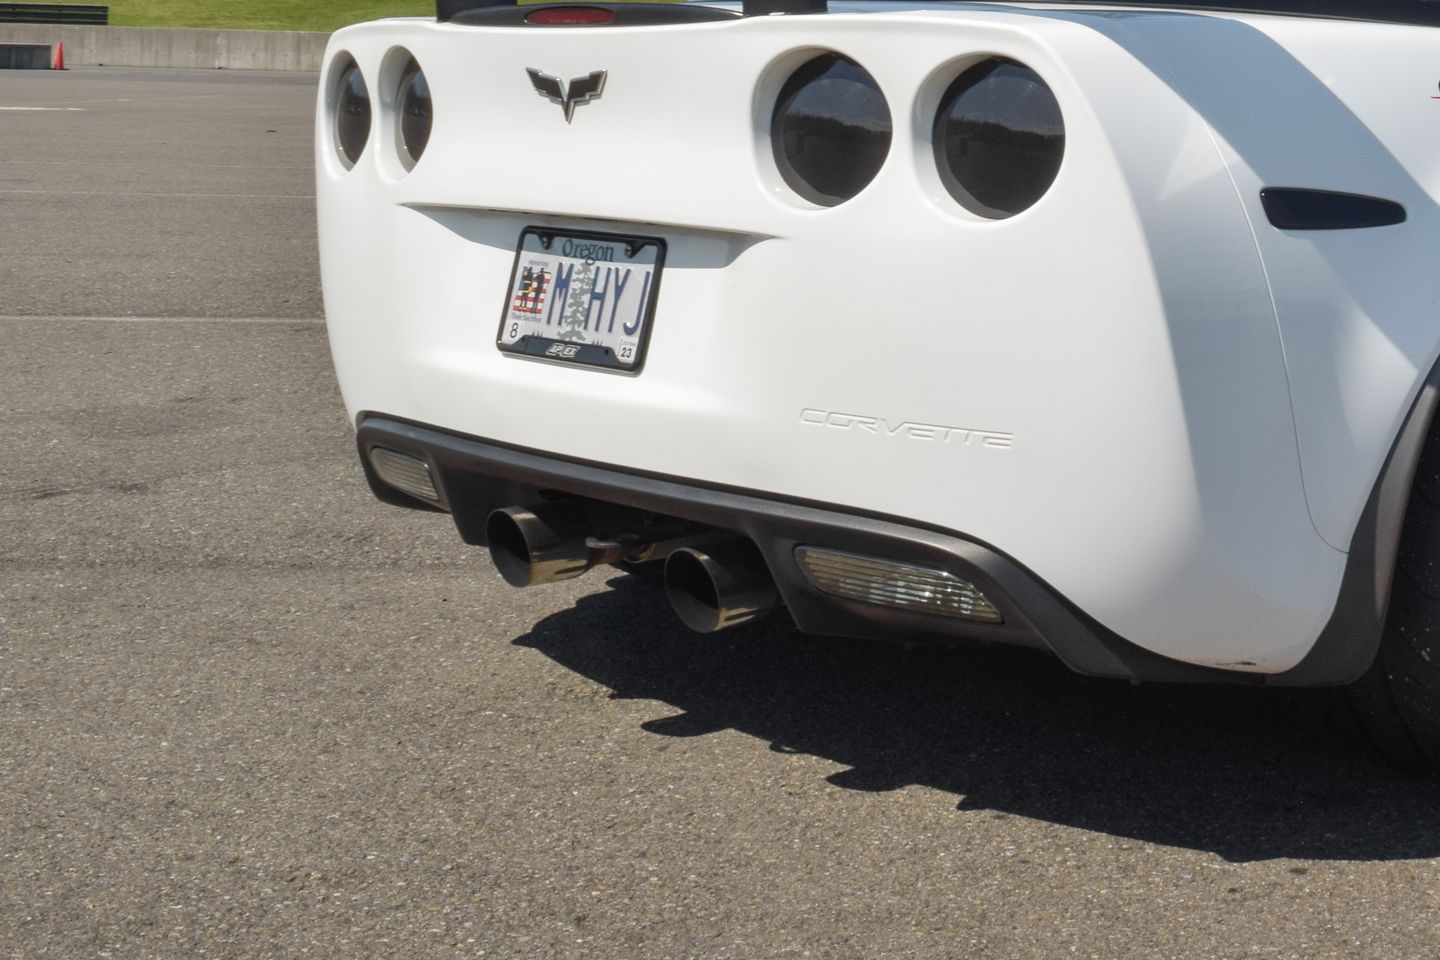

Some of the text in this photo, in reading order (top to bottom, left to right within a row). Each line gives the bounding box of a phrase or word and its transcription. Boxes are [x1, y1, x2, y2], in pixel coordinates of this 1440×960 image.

[562, 239, 615, 266] Oregon
[509, 322, 520, 339] 8
[620, 347, 633, 359] 23
[799, 407, 1016, 450] CORVETTE
